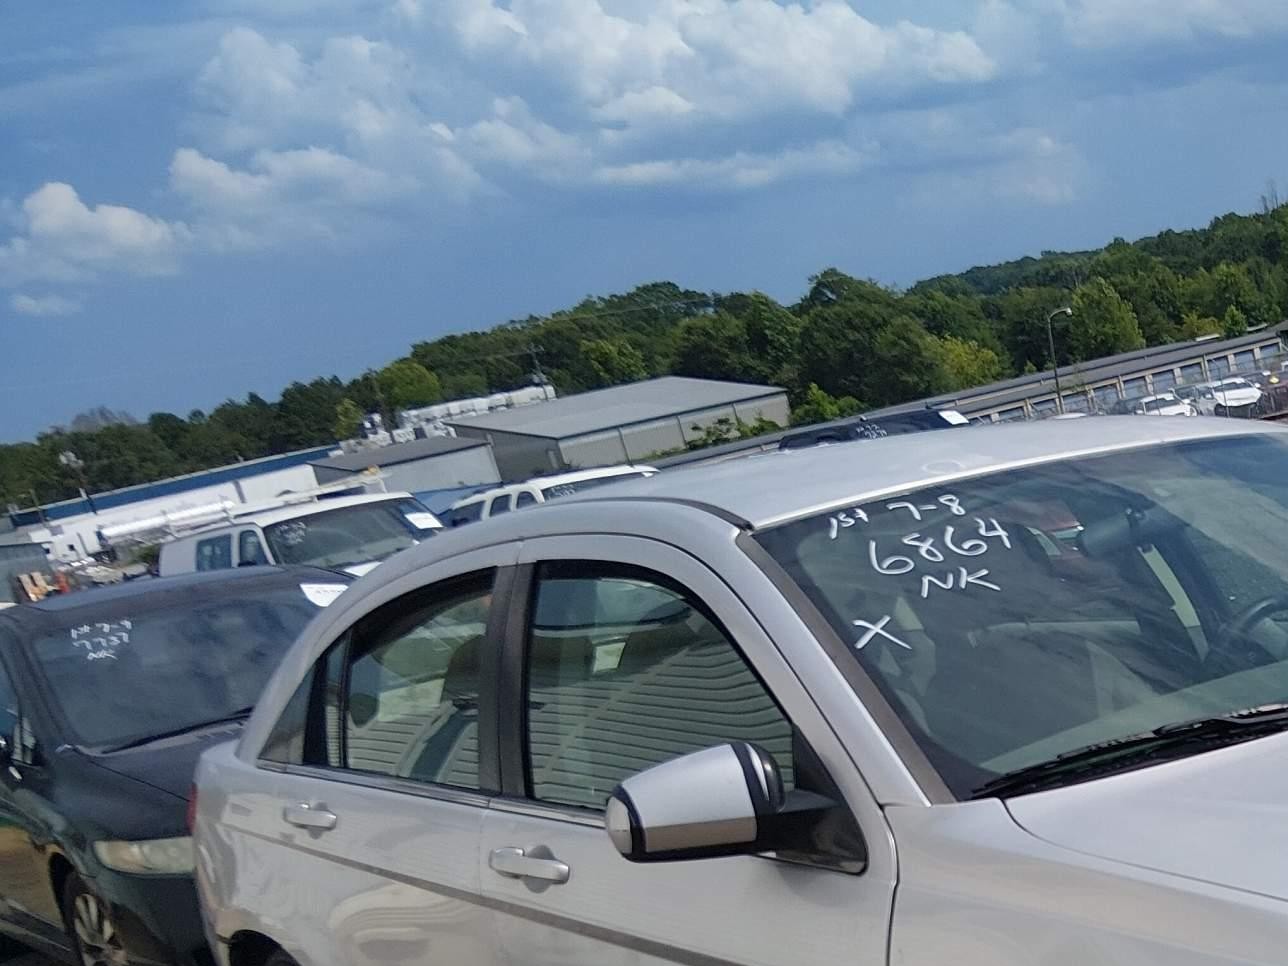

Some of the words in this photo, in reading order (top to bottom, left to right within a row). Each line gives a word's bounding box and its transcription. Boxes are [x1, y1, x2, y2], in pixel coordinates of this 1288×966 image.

[886, 494, 966, 520] 7-8
[869, 517, 1011, 575] 6864
[921, 566, 1001, 598] NK
